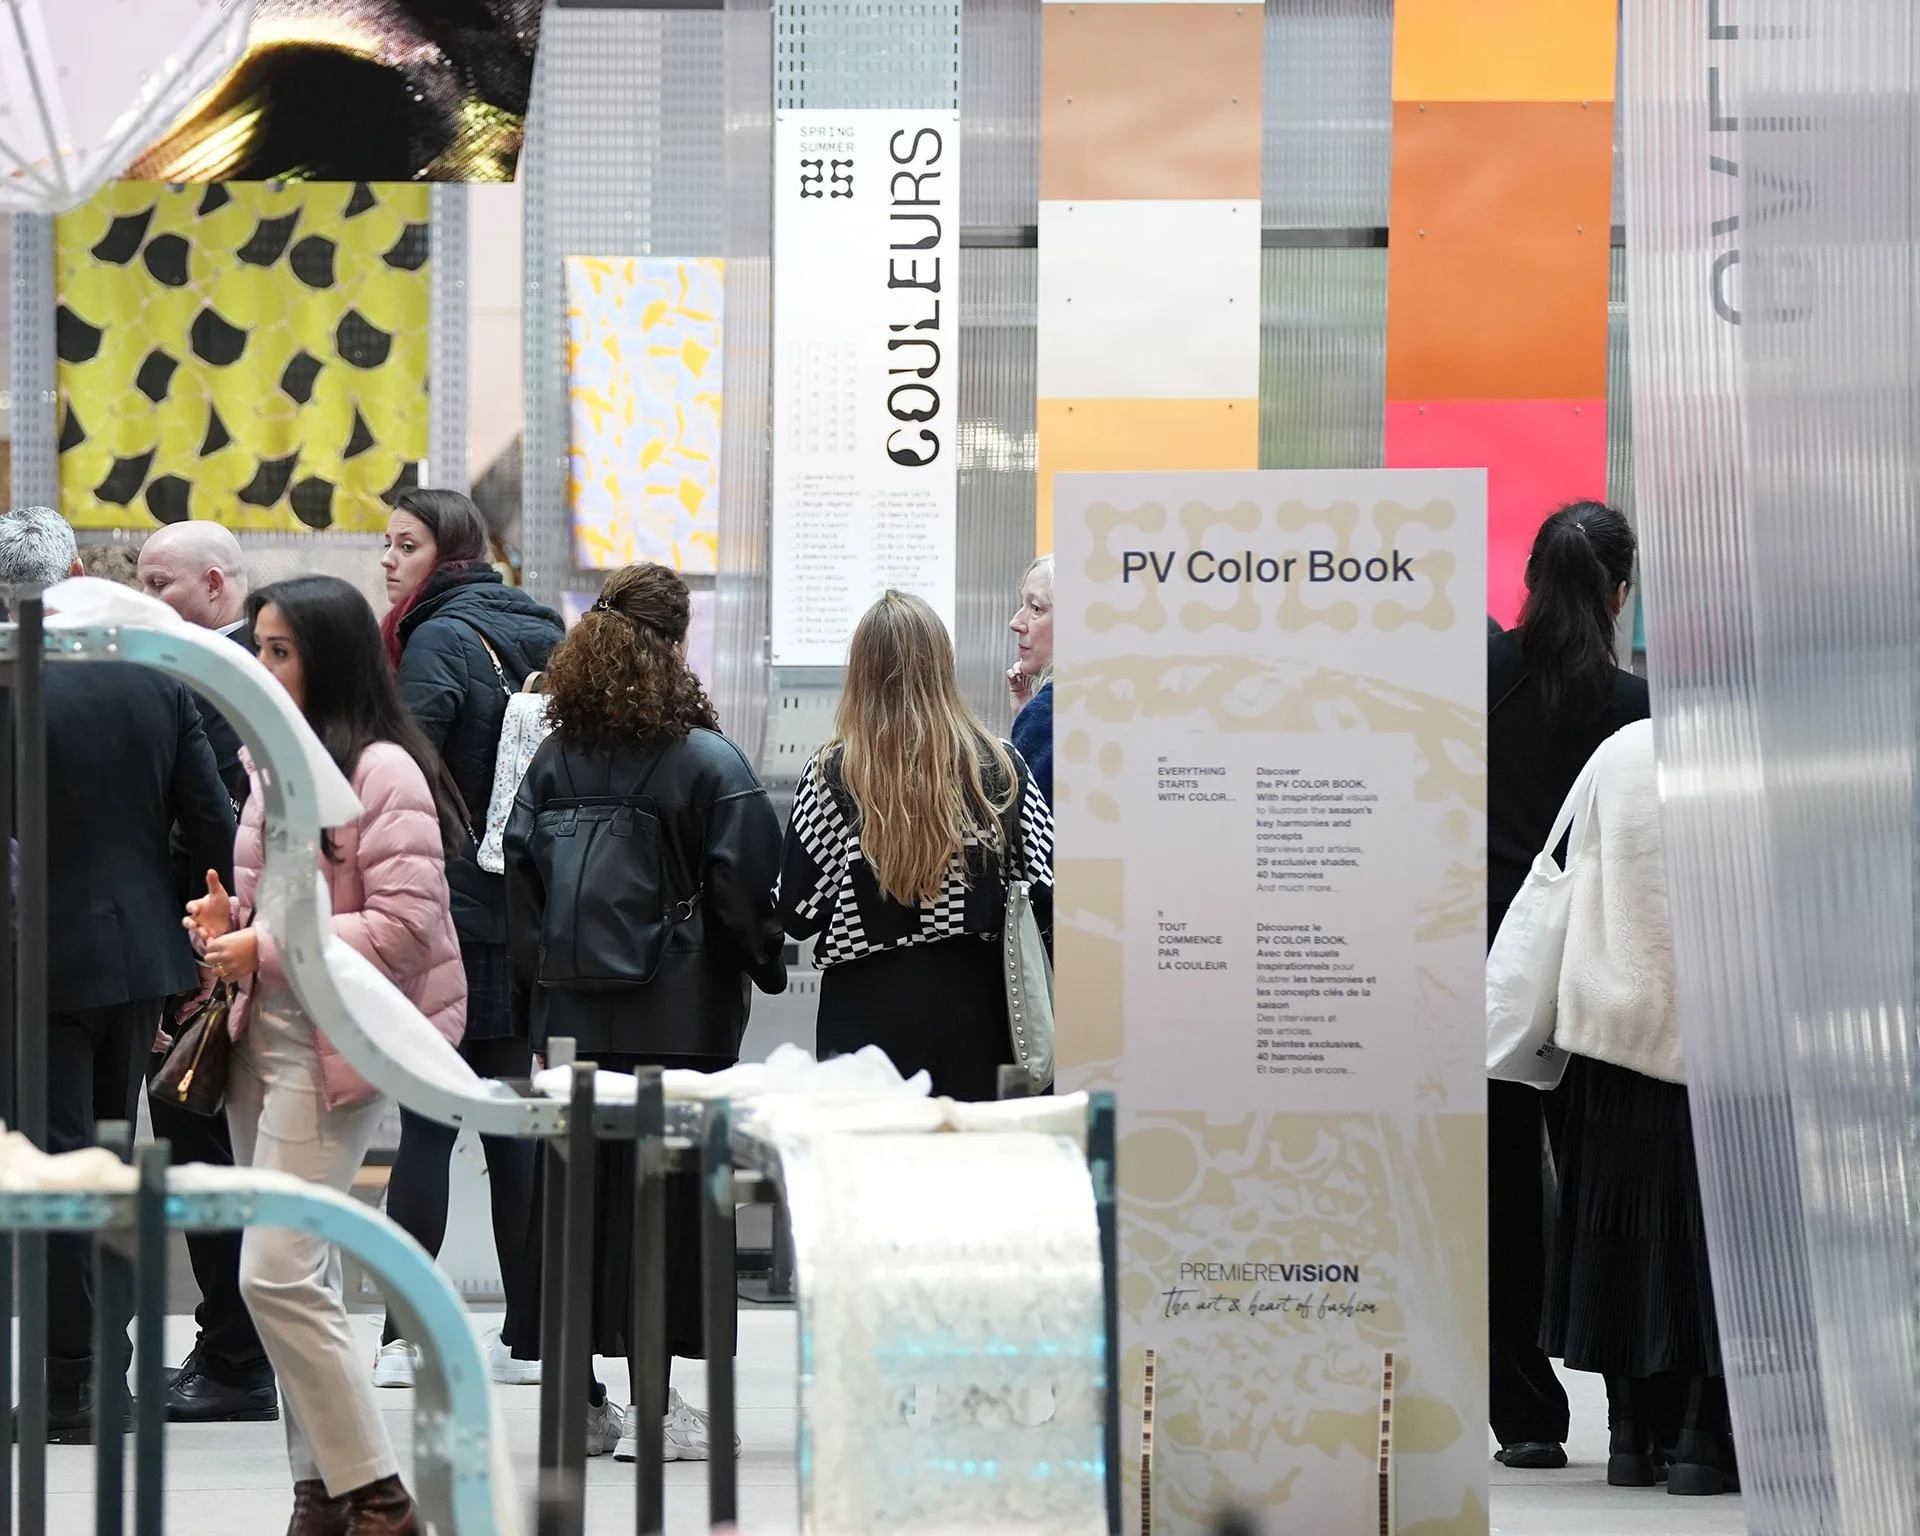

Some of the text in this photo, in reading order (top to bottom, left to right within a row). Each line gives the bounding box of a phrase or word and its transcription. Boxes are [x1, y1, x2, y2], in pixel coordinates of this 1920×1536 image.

[800, 127, 855, 137] SPRING
[800, 142, 855, 153] SUMMER
[887, 127, 943, 467] COULEURS
[1123, 550, 1414, 583] PV Color Book
[1158, 767, 1226, 775] EVERYTHING
[1256, 767, 1301, 775] Discover
[1158, 780, 1198, 788] STARTS
[1256, 780, 1272, 788] the
[1275, 780, 1289, 788] PV
[1291, 780, 1329, 788] COLOR
[1158, 793, 1185, 801] WITH
[1256, 793, 1279, 801] With
[1282, 793, 1343, 802] inspirational
[1256, 819, 1352, 829] key harmonies and
[1256, 833, 1303, 842] concepts
[1256, 858, 1359, 866] 29 exclusive shades,
[1271, 871, 1324, 879] harmonies
[1256, 883, 1276, 892] And
[1158, 923, 1187, 931] TOUT
[1158, 936, 1222, 944] COMMENCE
[1257, 936, 1270, 944] PV
[1273, 936, 1311, 944] COLOR
[1158, 949, 1179, 957] PAR
[1256, 949, 1281, 957] Avec
[1158, 962, 1227, 970] LA COULEUR
[1256, 962, 1330, 971] inspirationnels
[1257, 988, 1271, 996] les
[1274, 989, 1320, 997] concepts
[1361, 988, 1371, 996] la
[1257, 1013, 1275, 1022] Des
[1257, 1040, 1269, 1048] 29
[1271, 1040, 1305, 1048] teintes
[1257, 1052, 1325, 1061] 40 harmonies
[1256, 1065, 1267, 1074] Et
[1269, 1066, 1290, 1074] bien
[1292, 1067, 1312, 1075] plus
